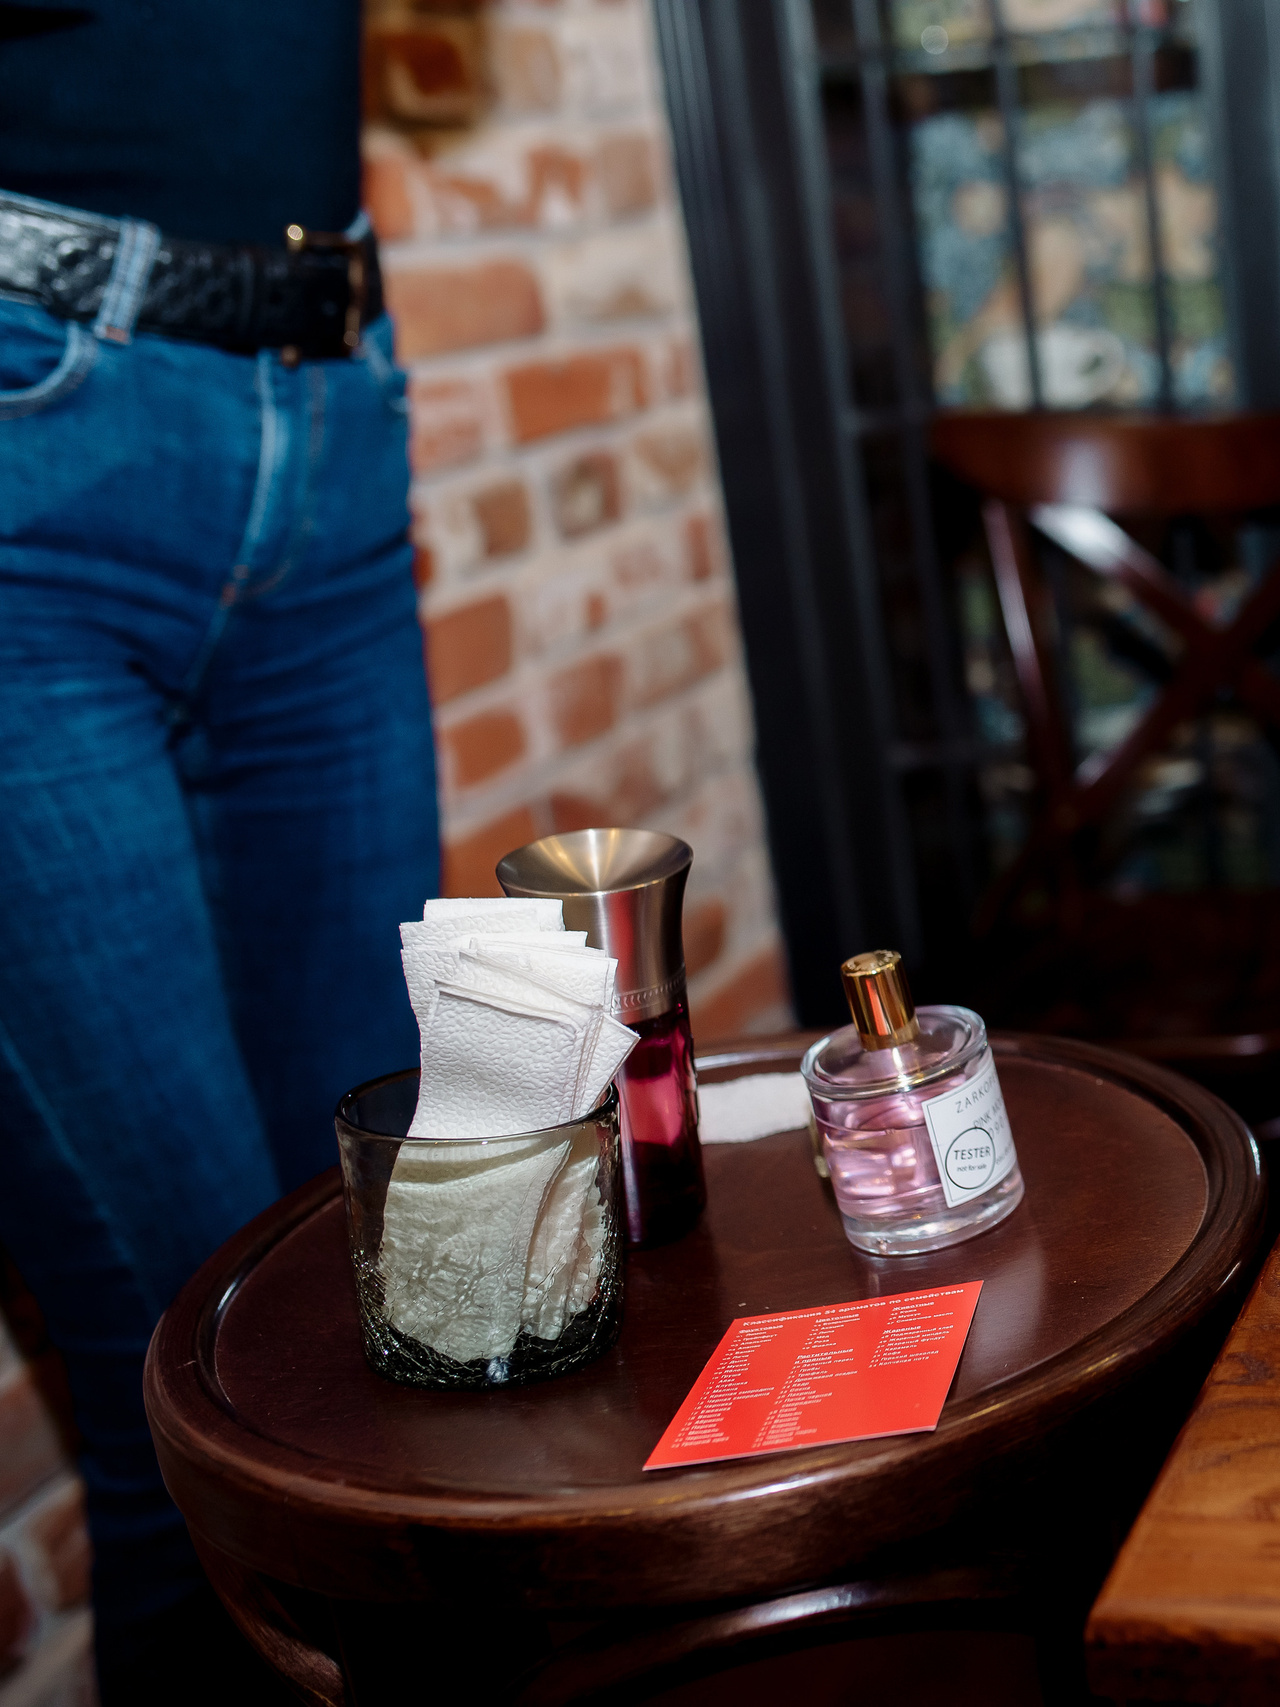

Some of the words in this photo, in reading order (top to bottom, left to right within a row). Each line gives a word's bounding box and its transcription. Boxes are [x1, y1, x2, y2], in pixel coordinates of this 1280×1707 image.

[953, 1146, 991, 1161] TESTER
[743, 1312, 821, 1326] Классификация
[838, 1302, 886, 1312] ароматов
[904, 1289, 964, 1302] семействам
[892, 1302, 934, 1311] Животные
[815, 1314, 859, 1323] Цветочные
[739, 1325, 783, 1333] Фруктовые
[882, 1325, 921, 1334] Жареные
[797, 1348, 853, 1359] Растительные
